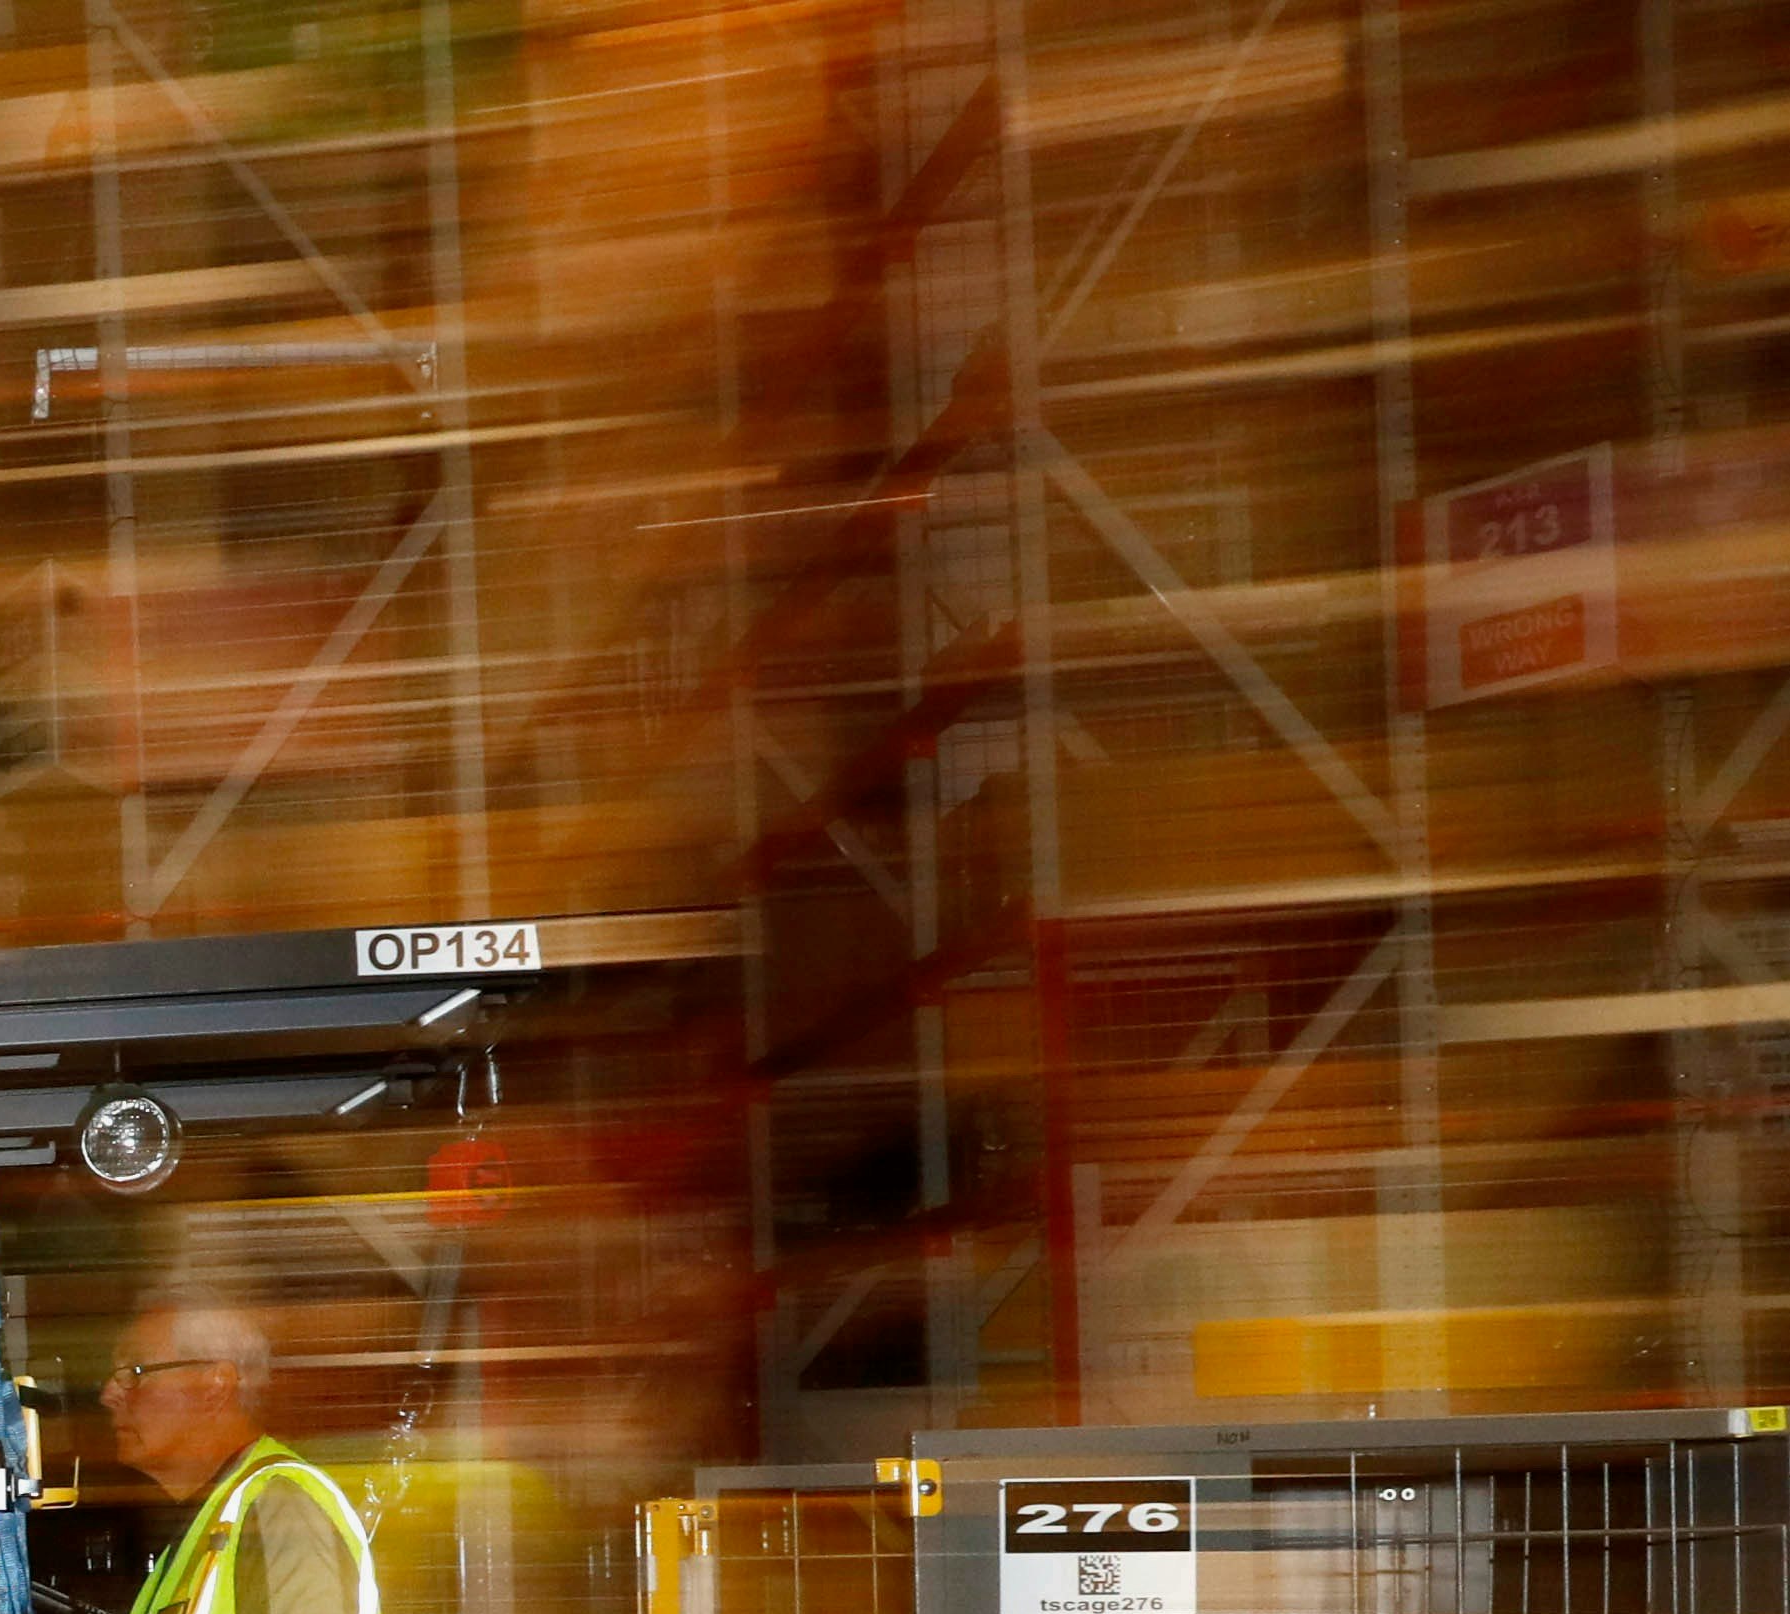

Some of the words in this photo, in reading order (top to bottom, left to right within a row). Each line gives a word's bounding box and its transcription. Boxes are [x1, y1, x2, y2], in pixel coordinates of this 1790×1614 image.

[1478, 503, 1561, 561] 213
[1468, 611, 1574, 650] WRONG
[1494, 640, 1553, 673] WAY
[369, 929, 530, 971] OP134
[1015, 1502, 1180, 1534] 276
[1040, 1597, 1164, 1614] tscage276
